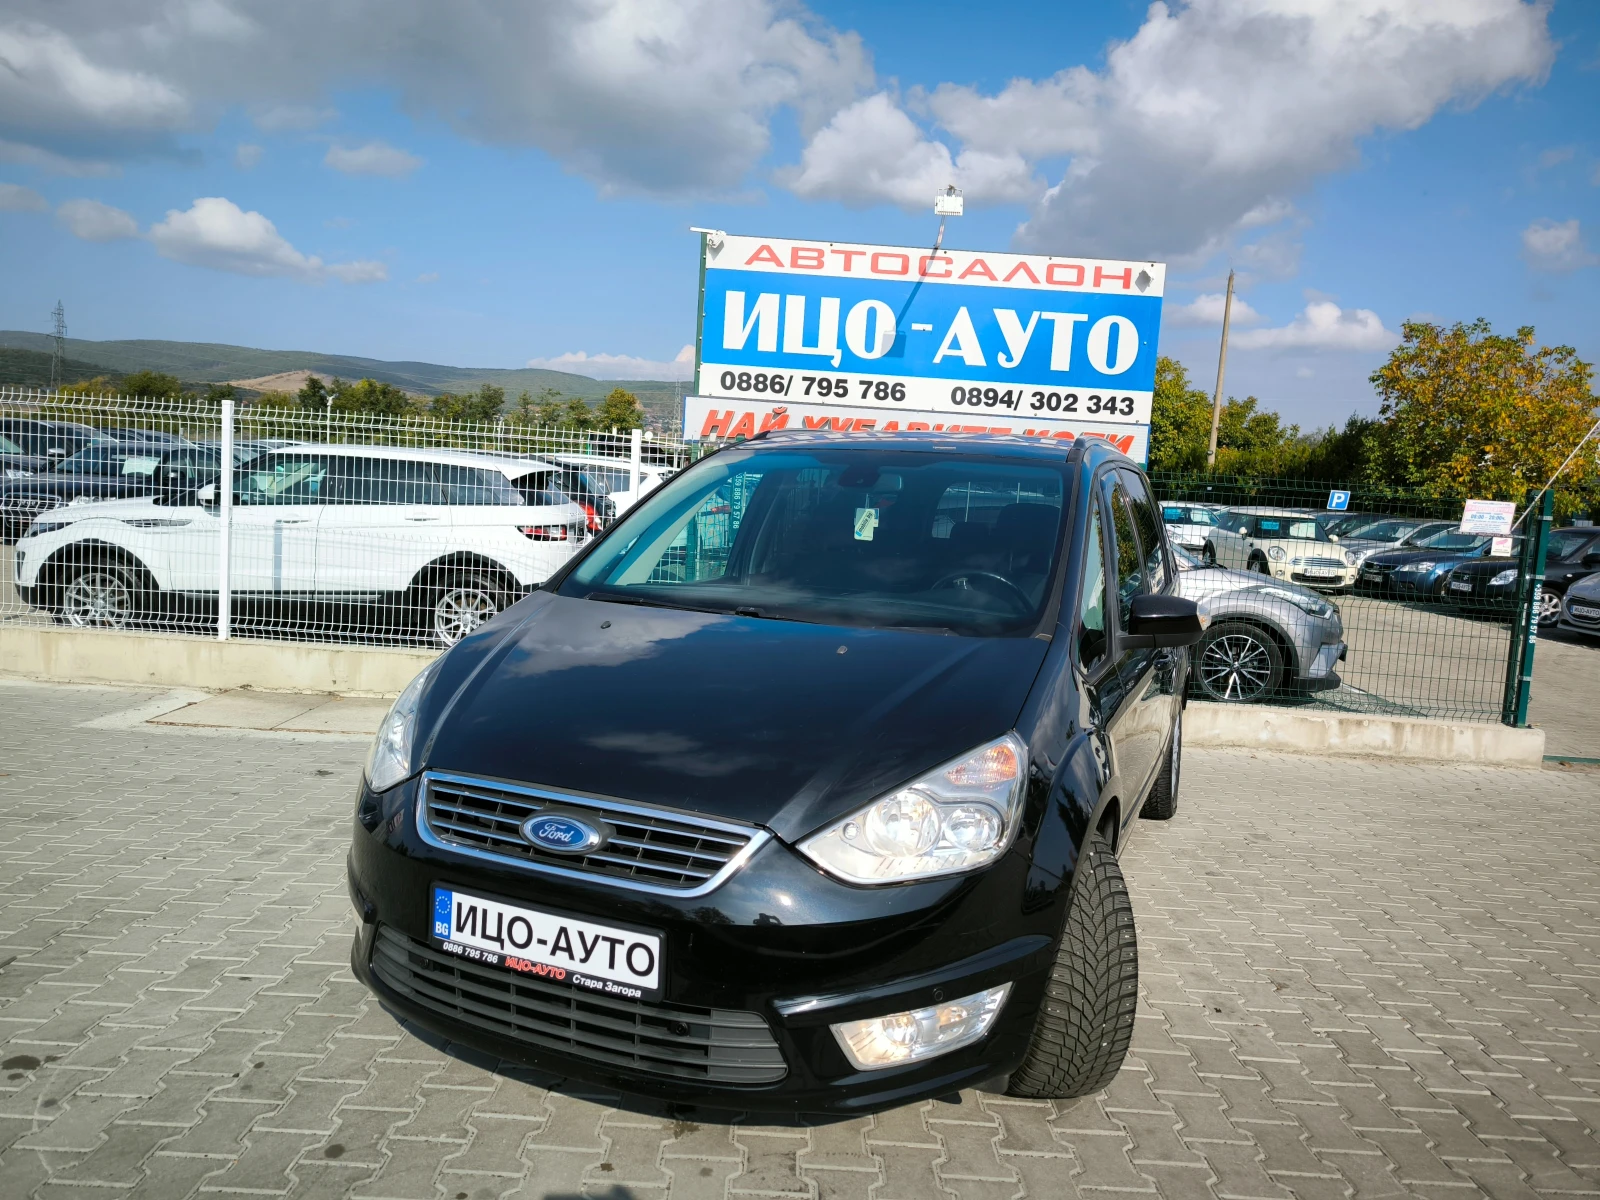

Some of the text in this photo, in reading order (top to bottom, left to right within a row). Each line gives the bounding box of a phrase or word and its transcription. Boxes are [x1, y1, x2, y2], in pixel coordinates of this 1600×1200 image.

[744, 244, 1132, 289] АВТОСАЛОН
[722, 290, 1139, 375] ИЦО-АУТО
[720, 371, 906, 402] 0886/ 795 786
[950, 386, 1135, 416] 0894/ 302 343
[700, 406, 790, 438] НАЙ
[1332, 492, 1345, 507] P
[1530, 615, 1539, 624] 79
[1532, 601, 1540, 614] 886
[1529, 625, 1538, 634] 57
[538, 822, 575, 842] Ford
[435, 921, 449, 936] BG
[455, 901, 655, 977] ИЦО-АУТО
[442, 941, 642, 998] 0886 795 786 ИЦО-АУТО Стара Загора
